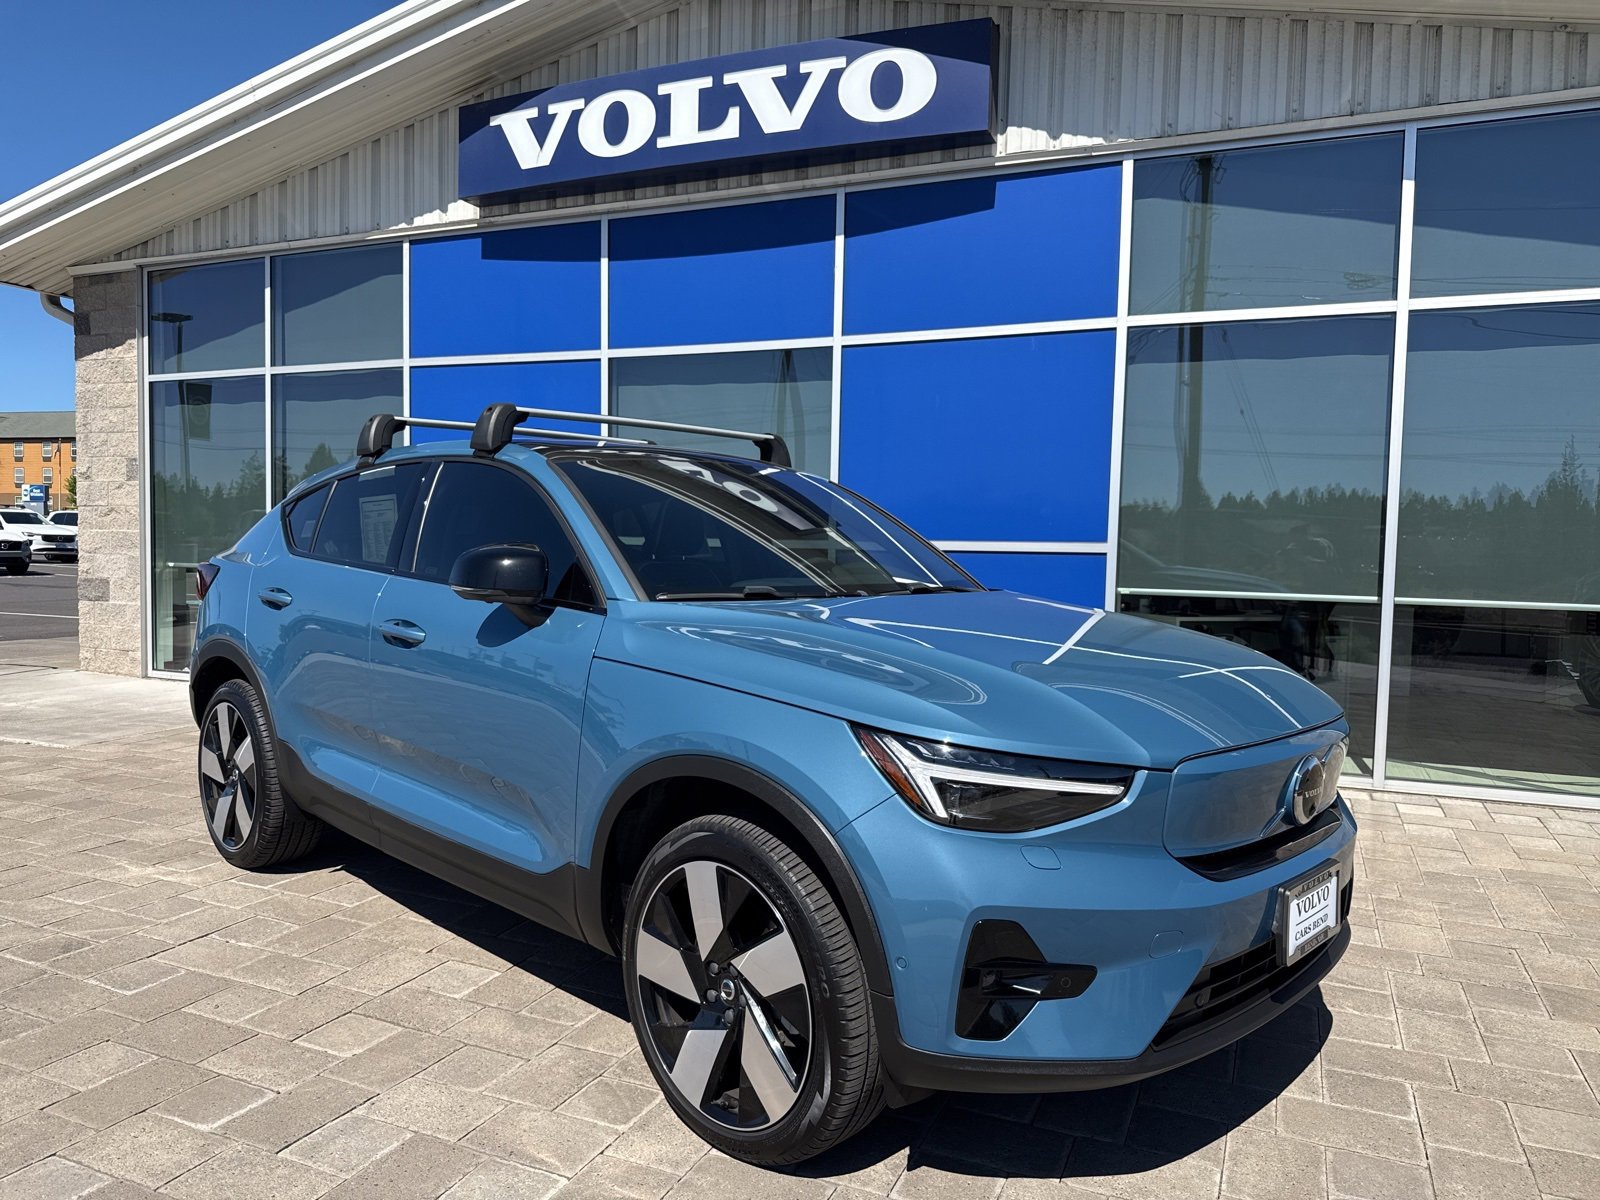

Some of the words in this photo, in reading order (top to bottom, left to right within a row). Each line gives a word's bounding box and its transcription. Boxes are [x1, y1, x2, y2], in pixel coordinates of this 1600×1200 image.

[490, 47, 937, 170] VOLVO
[1296, 885, 1330, 917] VOLVO
[1295, 924, 1312, 941] CARS
[1312, 913, 1329, 932] BEND
